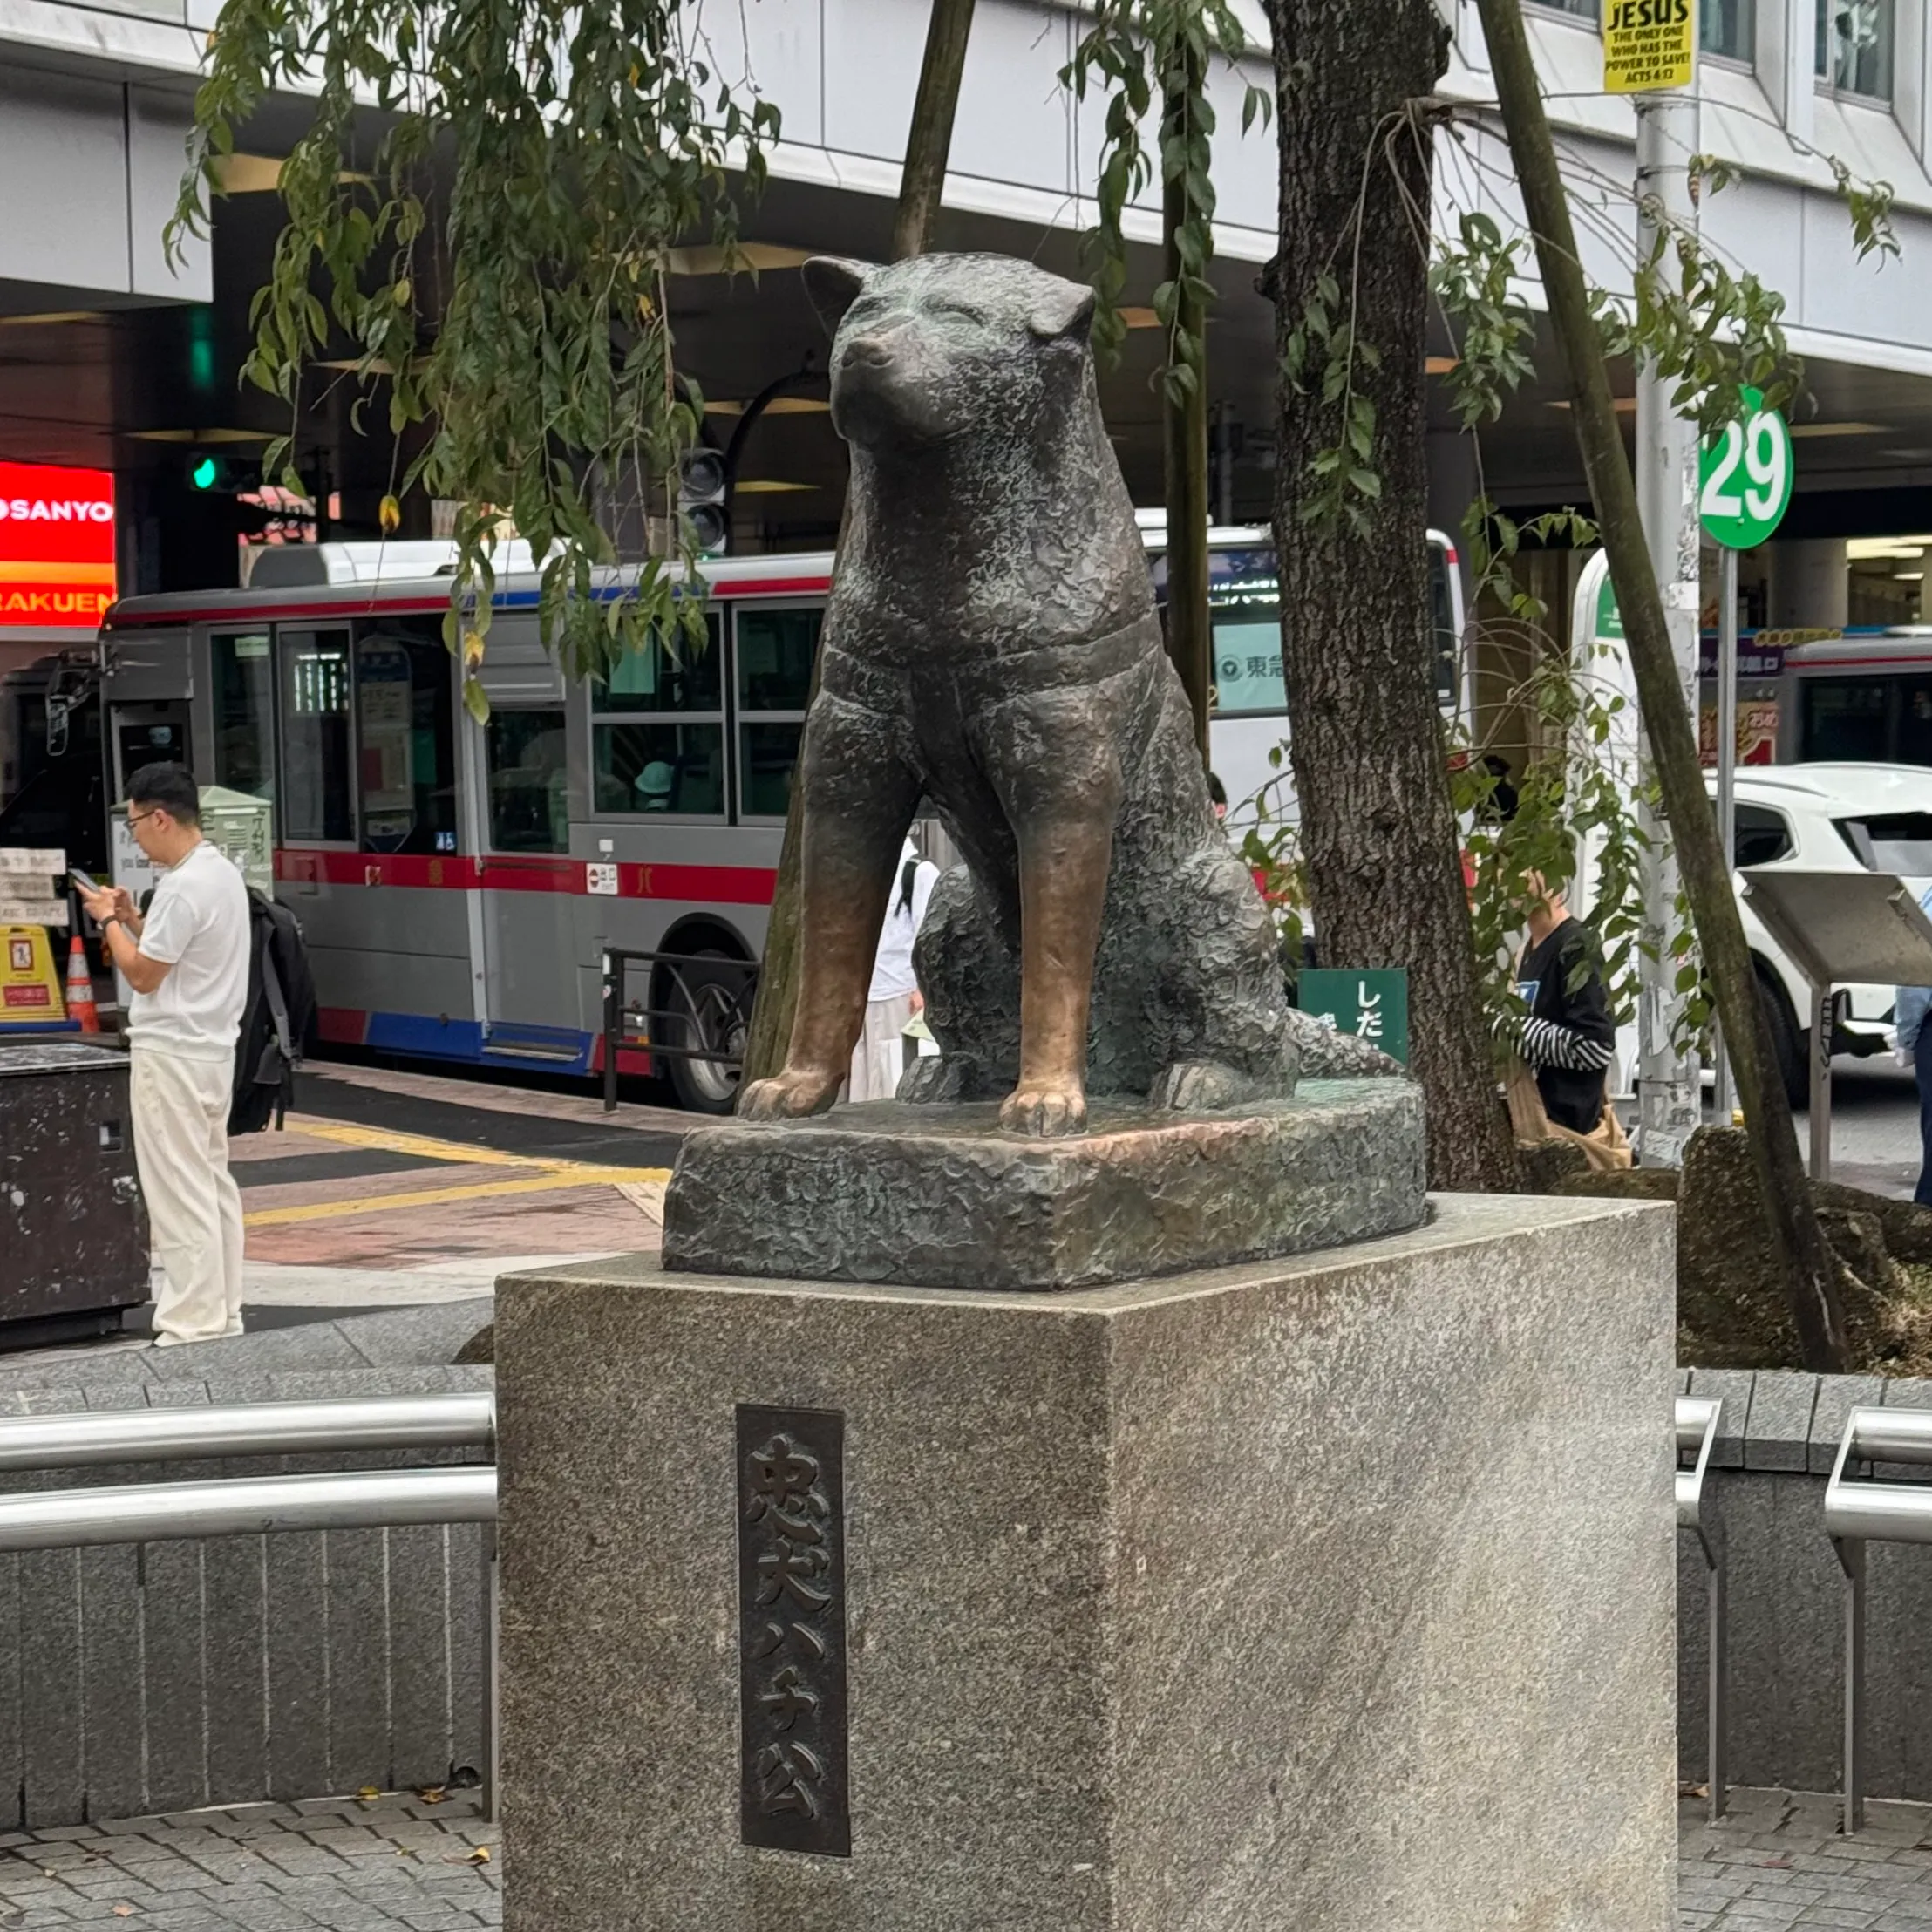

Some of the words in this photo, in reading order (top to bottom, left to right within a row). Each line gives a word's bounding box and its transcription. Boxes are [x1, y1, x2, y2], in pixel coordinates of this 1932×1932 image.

[1607, 0, 1688, 31] JESUS
[1613, 31, 1632, 44] THE
[1634, 28, 1662, 41] ONLY
[1663, 25, 1684, 37] ONE
[1611, 44, 1637, 58] WHO
[1639, 41, 1660, 54] HAS
[1663, 38, 1683, 51] THE
[1605, 57, 1643, 71] POWER
[1646, 55, 1660, 67] TO
[1624, 70, 1651, 84] ACTS
[1701, 410, 1786, 521] 29
[0, 591, 118, 616] AKUEN
[1356, 980, 1384, 1050] しだ
[746, 1432, 832, 1820] 忠犬ハチ公
